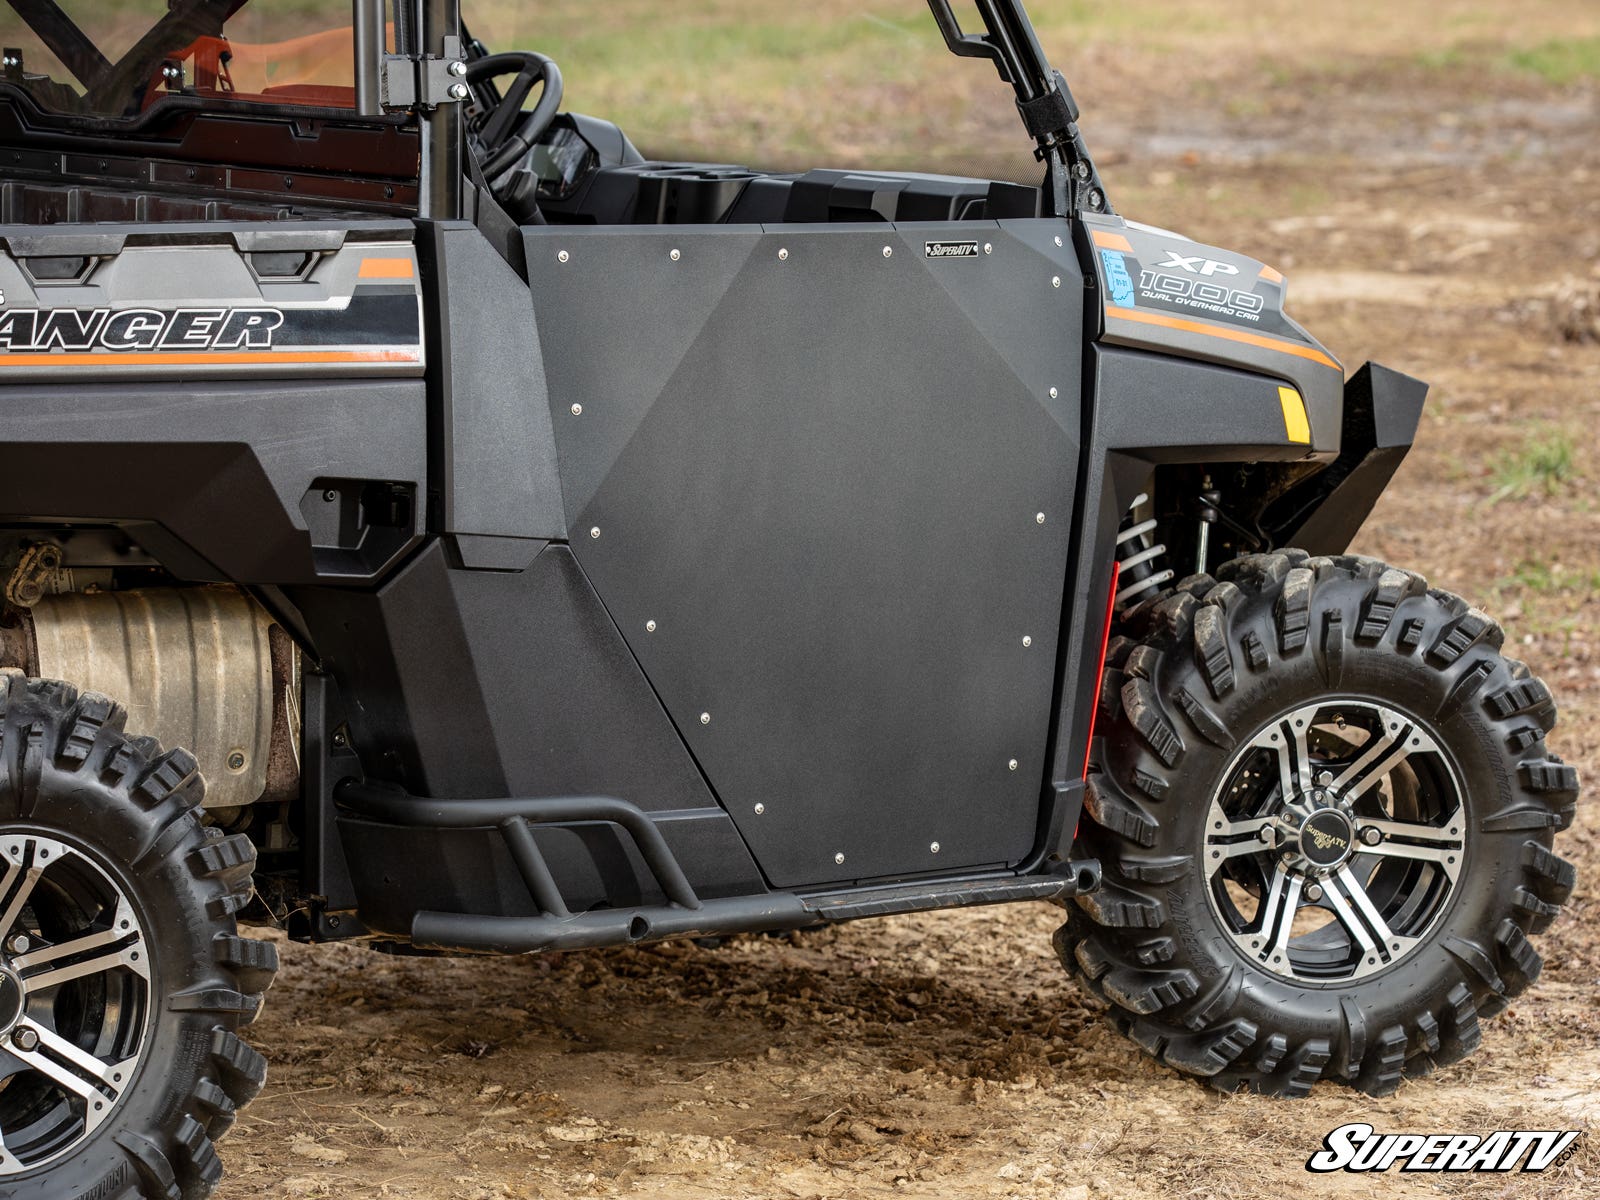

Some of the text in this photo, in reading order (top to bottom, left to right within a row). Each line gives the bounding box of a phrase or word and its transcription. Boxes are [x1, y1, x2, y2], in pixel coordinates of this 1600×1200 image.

[1154, 249, 1241, 277] XP
[1139, 269, 1265, 315] 1000
[1141, 290, 1261, 322] DUAL OVERHEAD CAM
